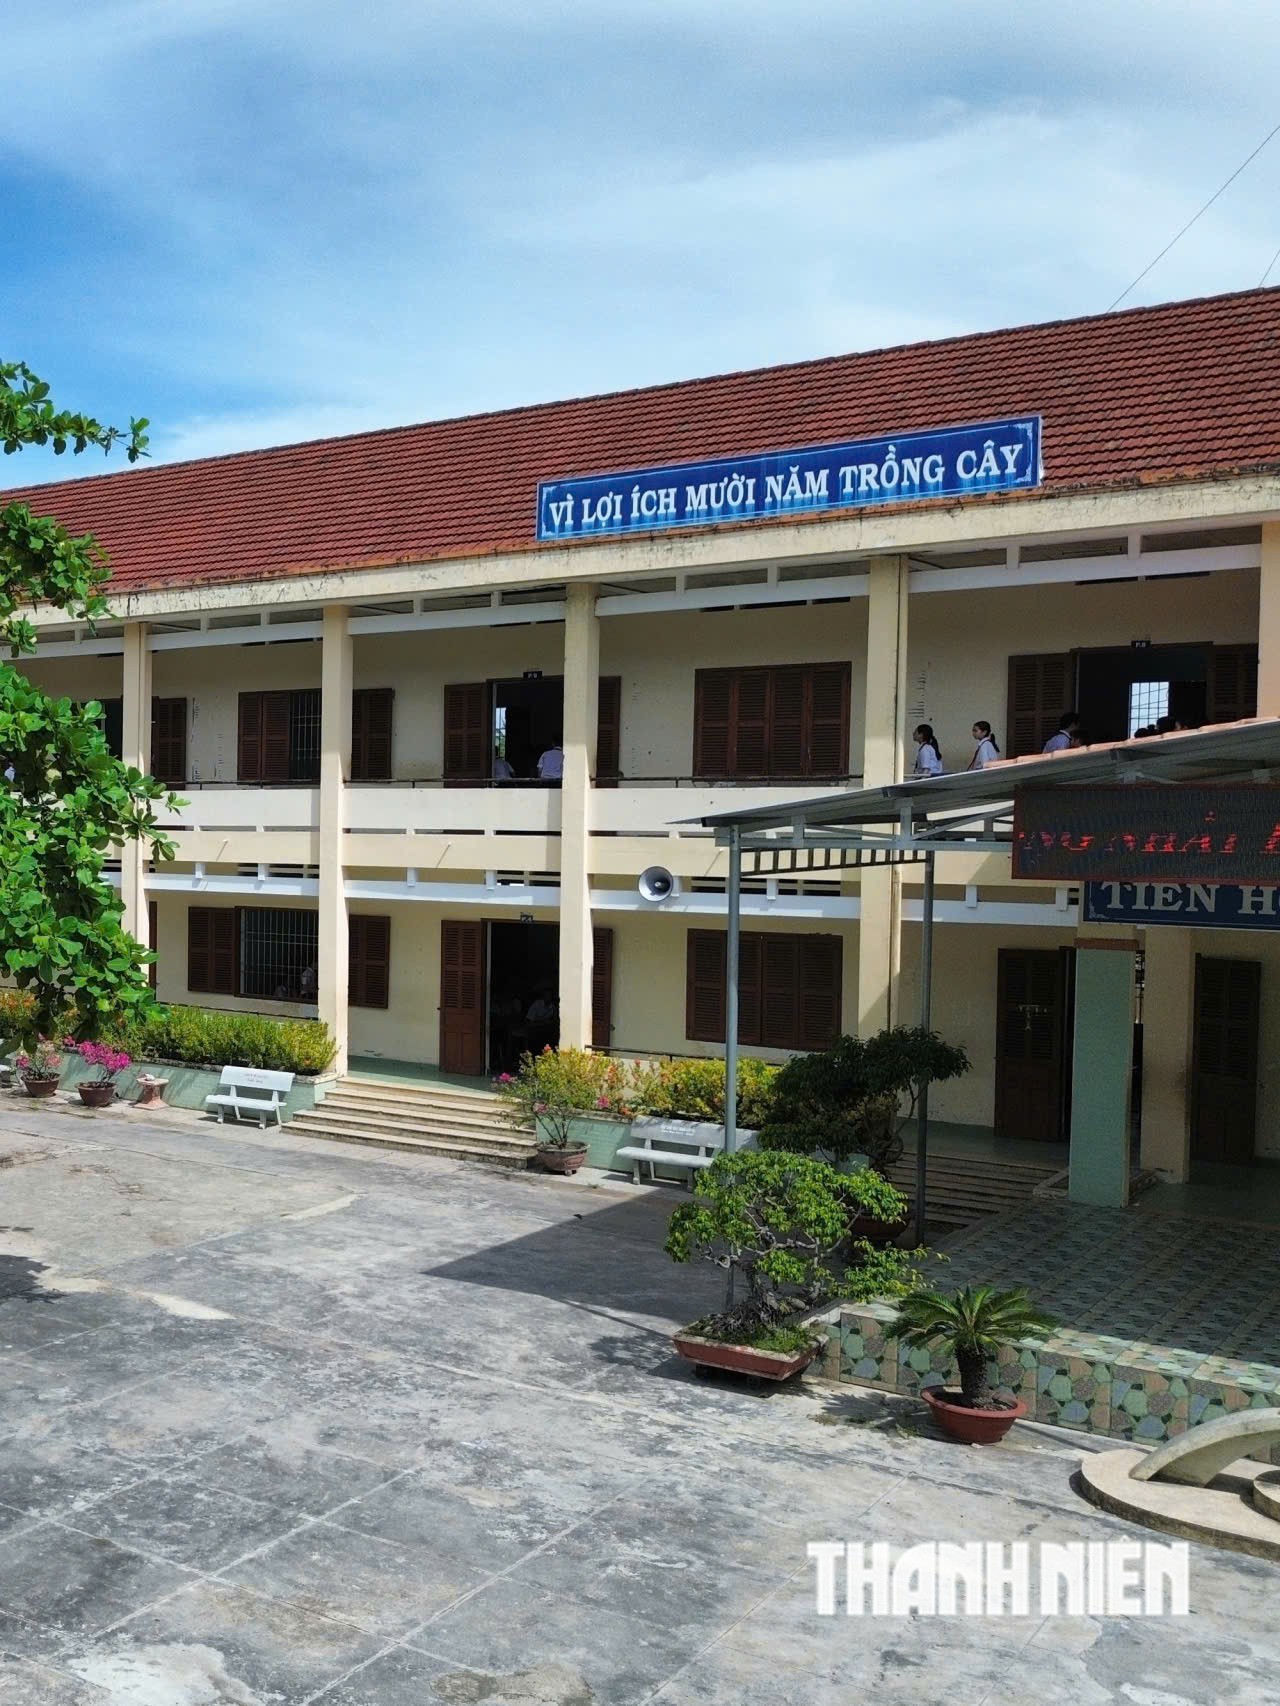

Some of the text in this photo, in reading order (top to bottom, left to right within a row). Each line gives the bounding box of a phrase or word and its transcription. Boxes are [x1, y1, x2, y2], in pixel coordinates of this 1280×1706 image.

[549, 439, 1023, 527] VÌ LỢI ÍCH MƯỜI NĂM TRỒNG CÂY
